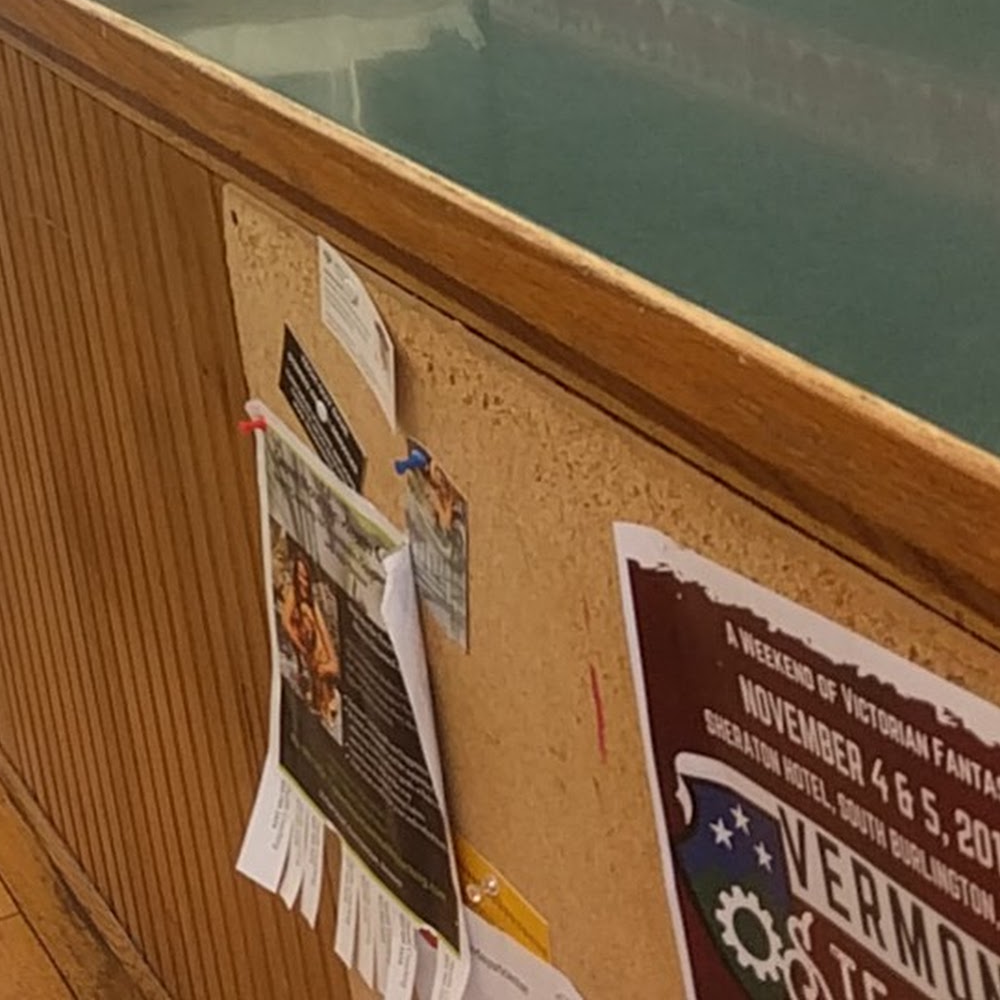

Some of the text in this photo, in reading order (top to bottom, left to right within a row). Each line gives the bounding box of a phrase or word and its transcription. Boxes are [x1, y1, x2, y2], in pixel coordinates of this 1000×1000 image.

[725, 620, 739, 648] A
[738, 627, 815, 691] WEEKEND
[816, 673, 838, 704] OF
[841, 683, 930, 761] VICTORIAN
[738, 673, 866, 787] NOVEMBER
[871, 757, 889, 804] 4
[920, 787, 950, 847] 5,
[704, 708, 782, 777] SHERATON
[782, 754, 836, 816] HOTEL,
[837, 792, 887, 849] SOUTH
